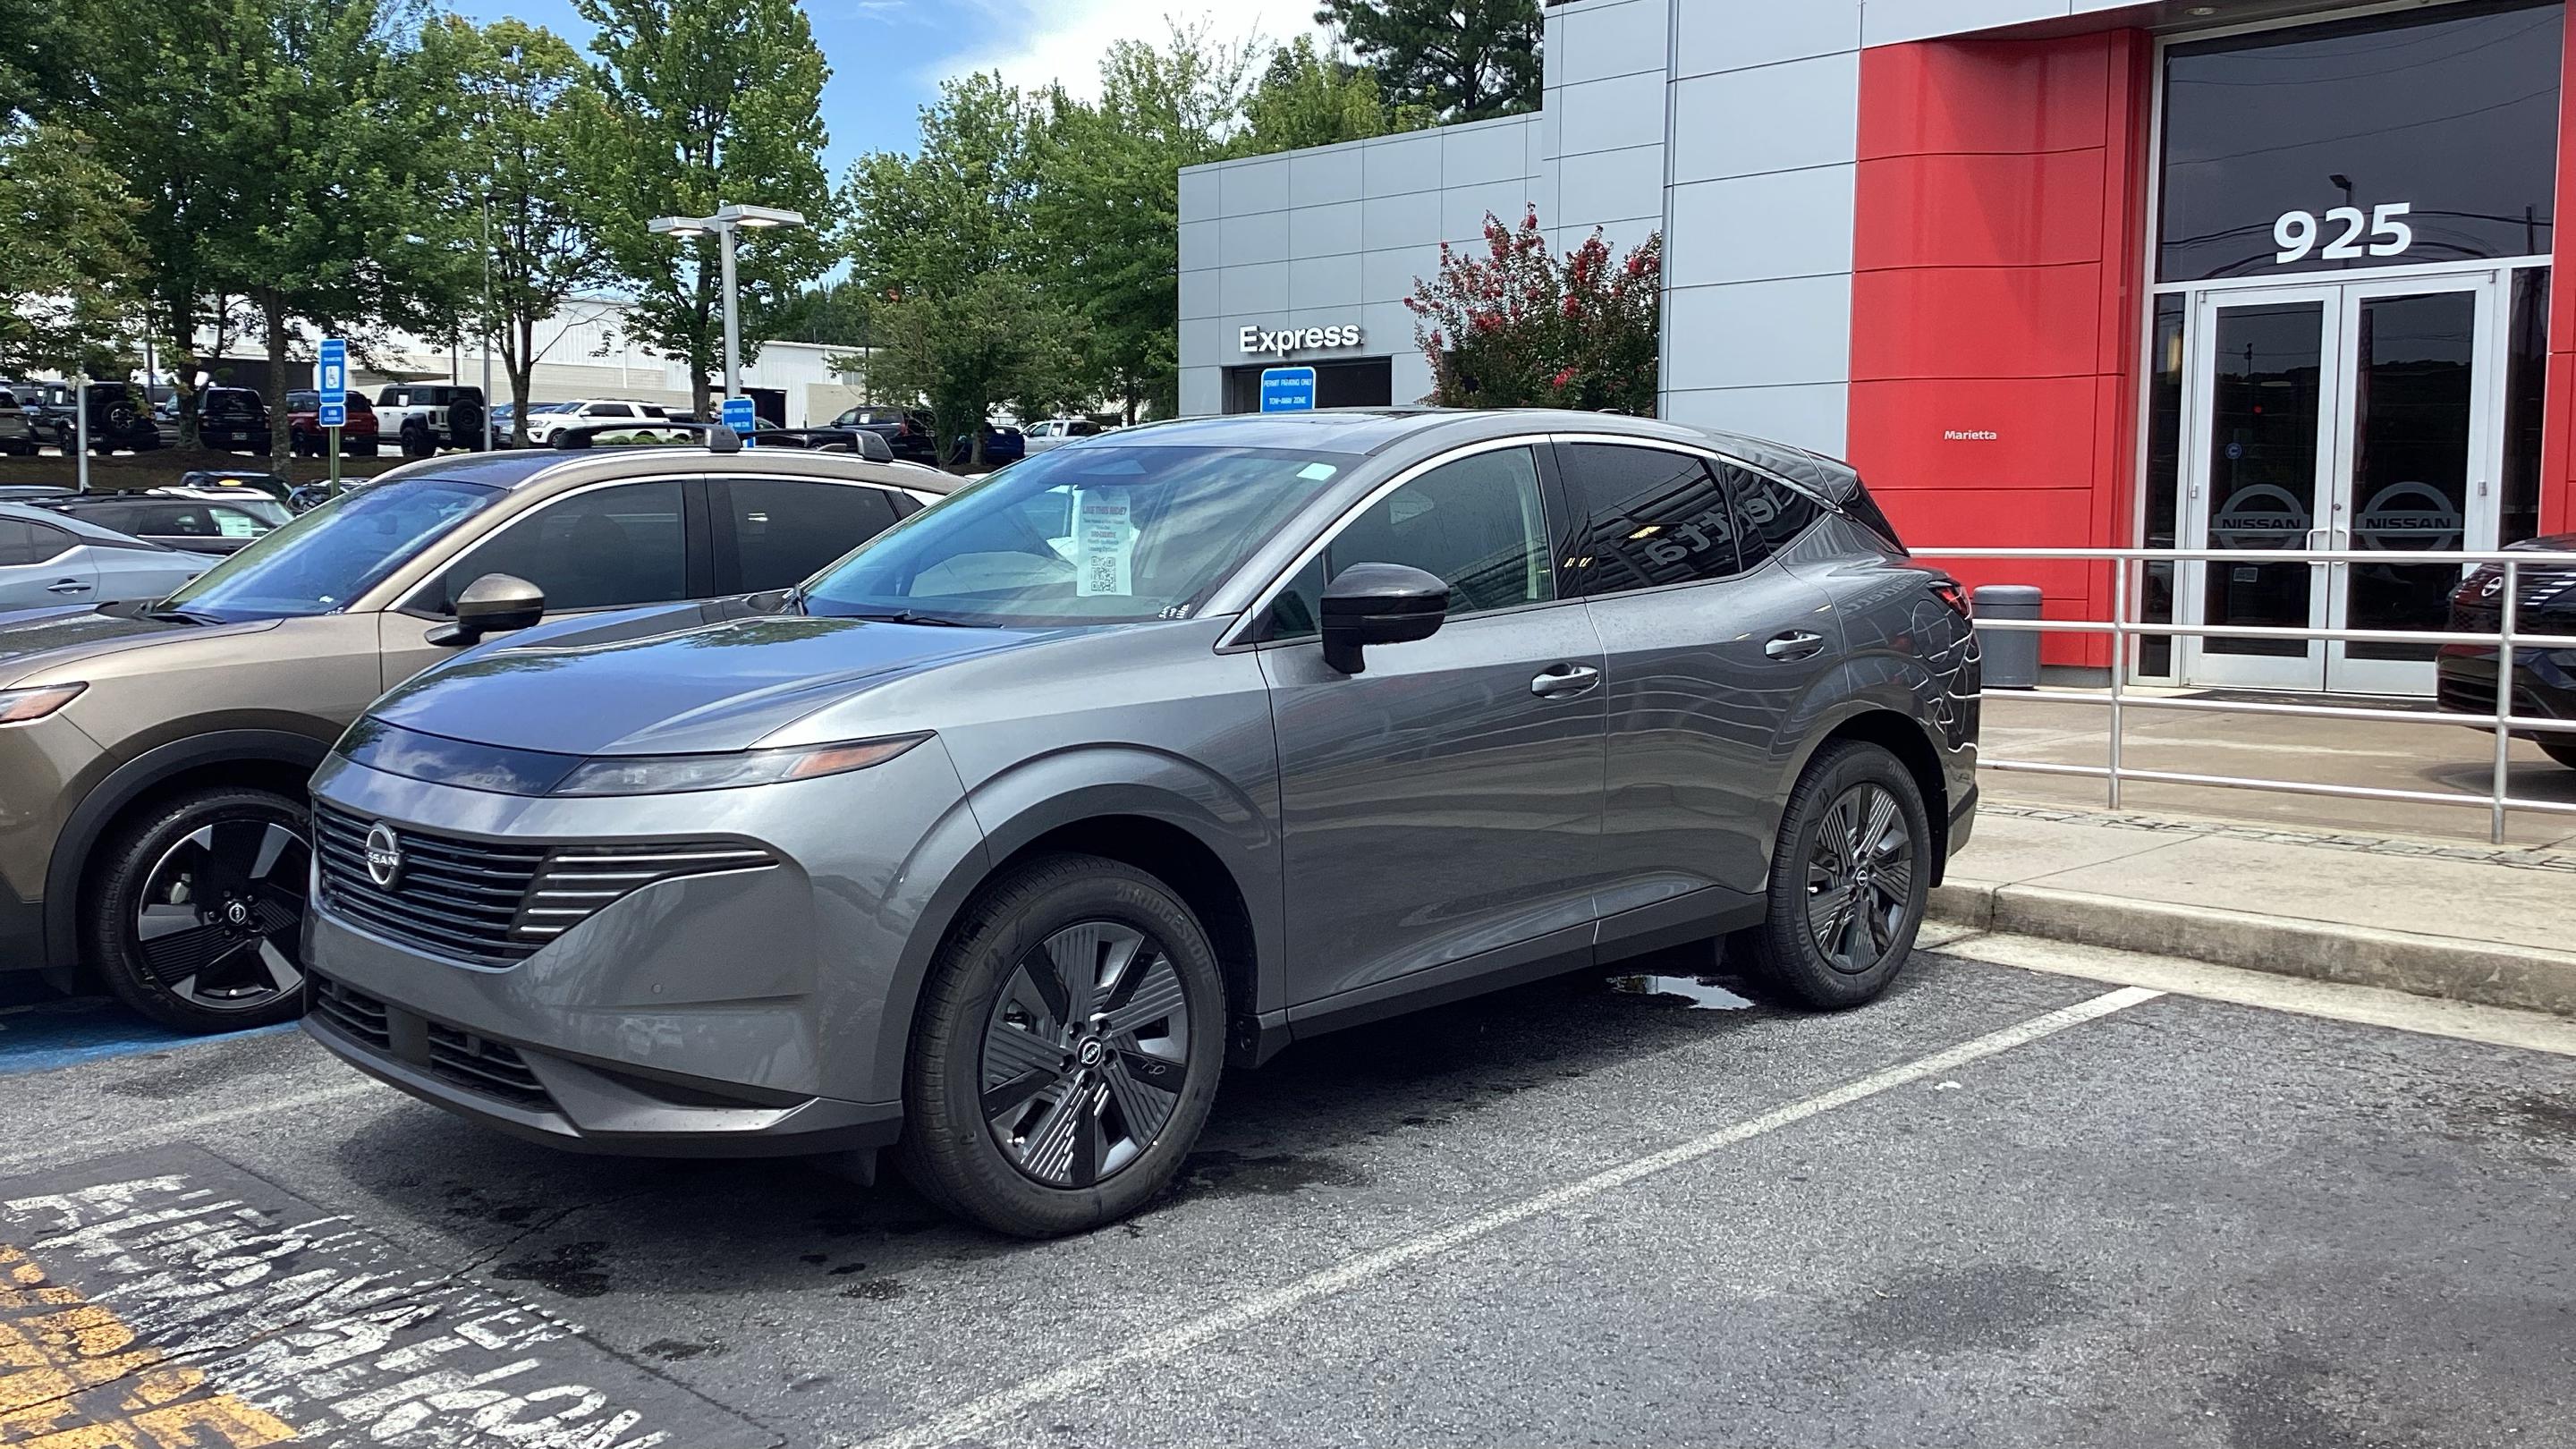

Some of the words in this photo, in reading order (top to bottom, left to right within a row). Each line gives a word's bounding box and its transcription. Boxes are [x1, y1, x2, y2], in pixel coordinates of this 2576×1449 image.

[2273, 202, 2412, 264] 925
[1240, 325, 1360, 357] Express
[1281, 378, 1300, 386] PARKING
[1293, 396, 1307, 404] ZONE
[1944, 429, 1997, 441] Marietta
[2222, 518, 2301, 530] NISSAN
[2365, 517, 2452, 530] NISSAN
